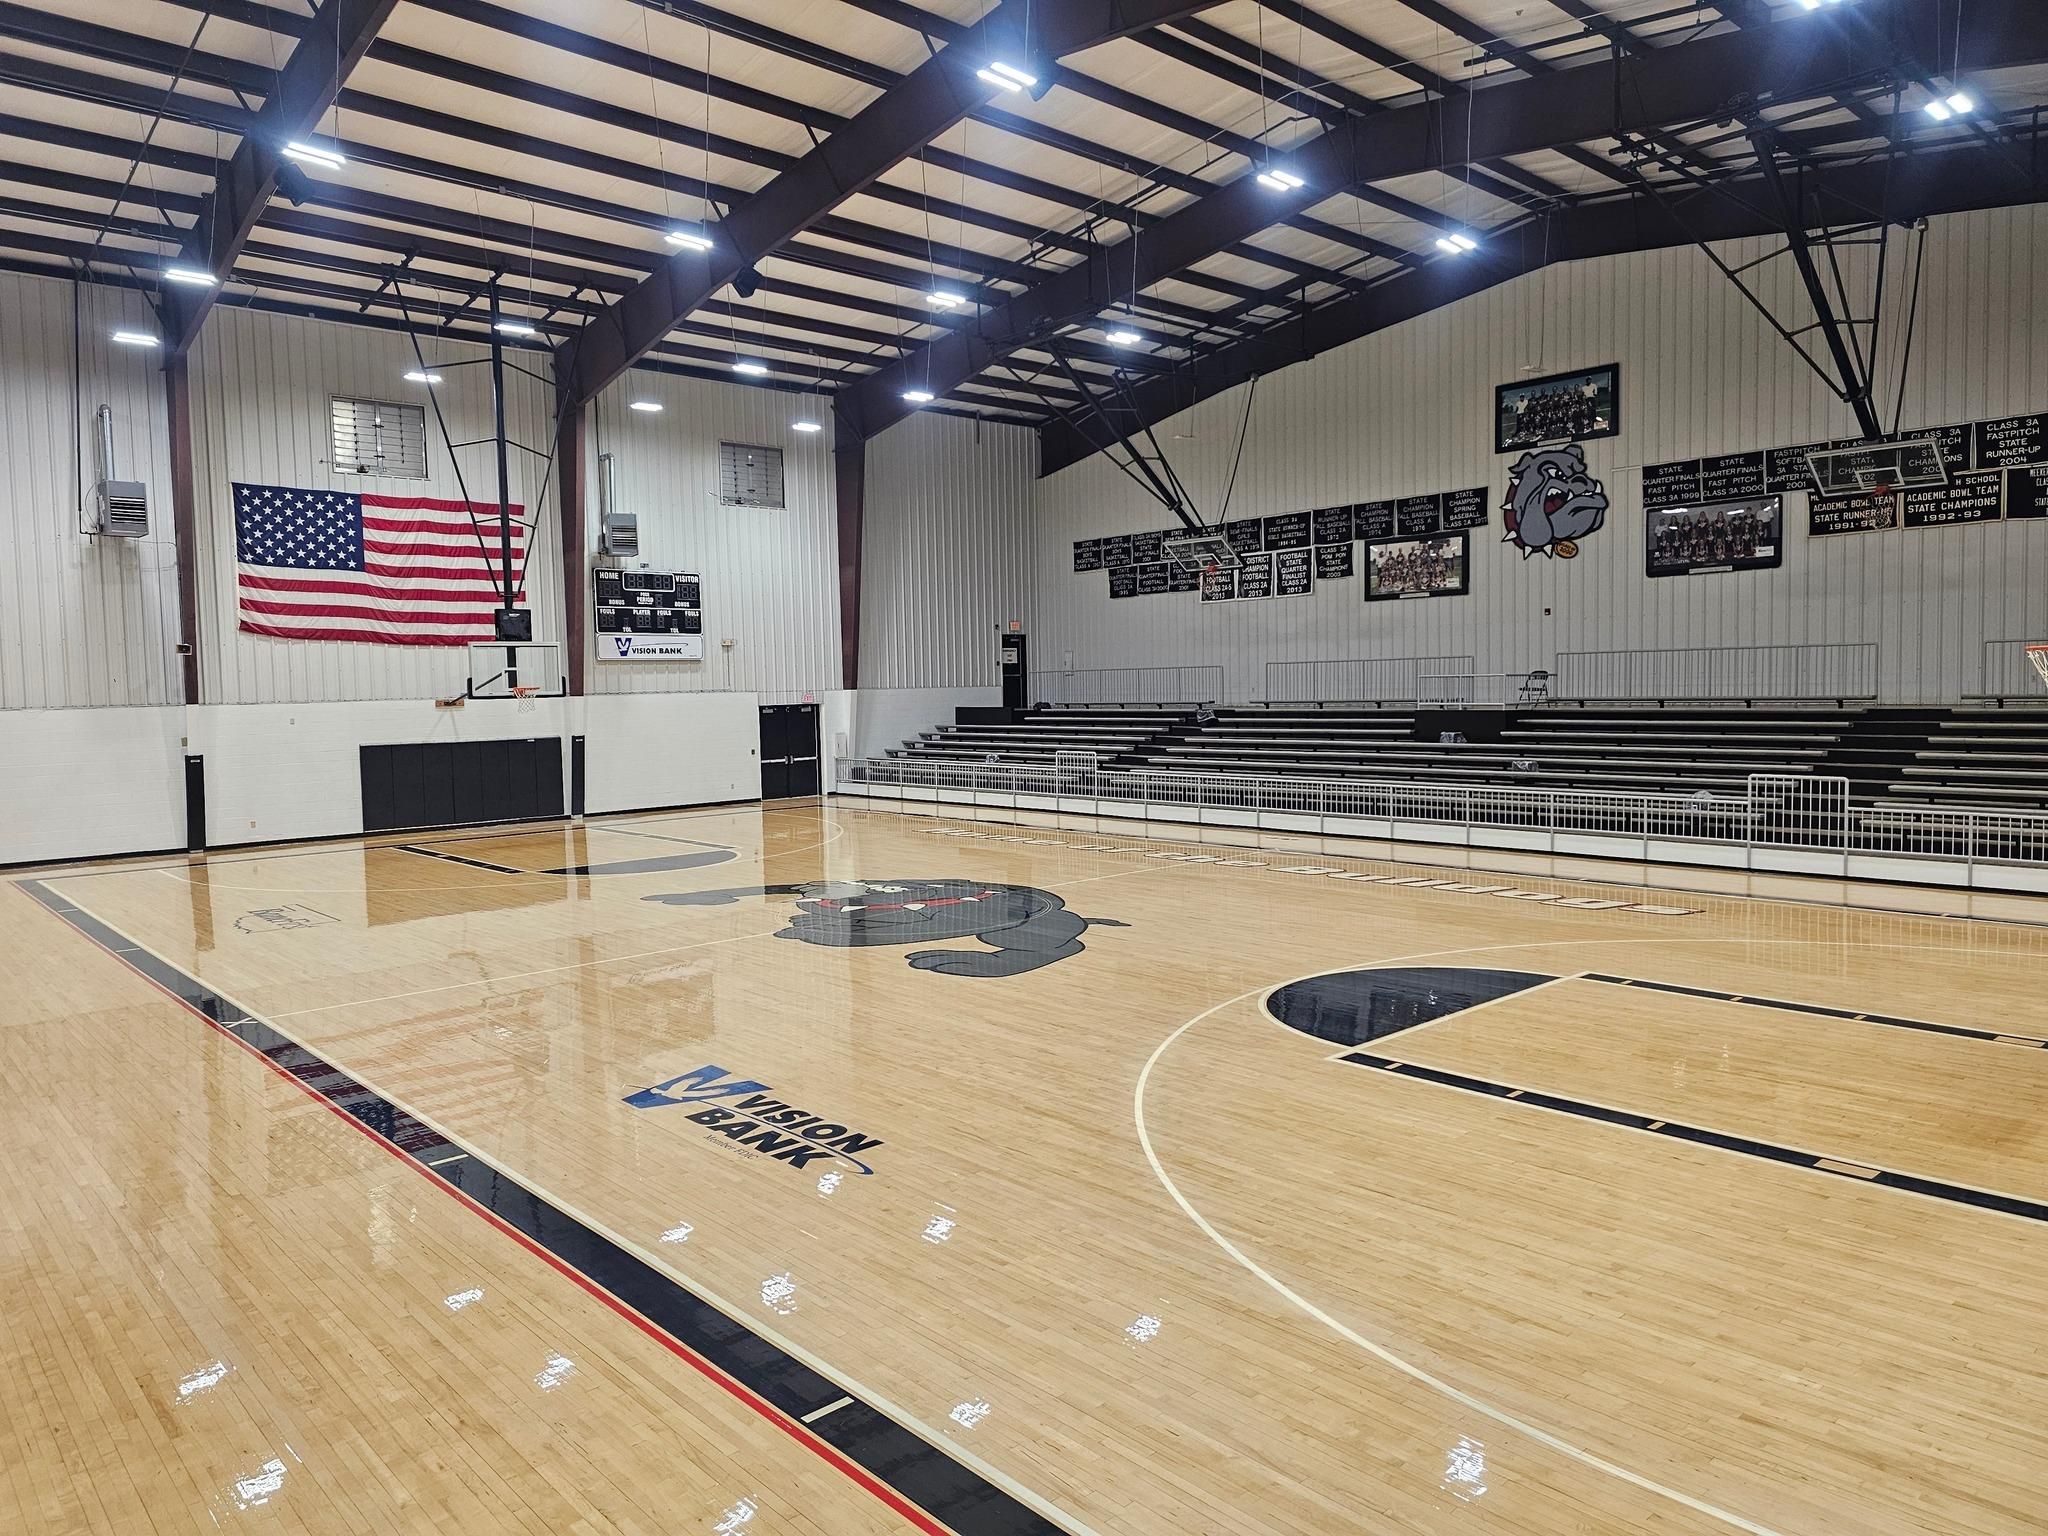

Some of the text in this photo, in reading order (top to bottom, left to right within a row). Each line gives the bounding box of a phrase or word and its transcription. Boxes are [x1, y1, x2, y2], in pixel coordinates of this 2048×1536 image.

[1987, 420, 2019, 431] CLASS
[1949, 428, 1961, 436] 3A
[1986, 427, 2040, 440] FASTPITCH
[1999, 438, 2028, 448] STATE
[1774, 445, 1820, 458] FASTPITCH
[1986, 446, 2041, 458] RUNNER-UP
[1720, 457, 1745, 467] STATE
[2000, 457, 2027, 466] 2004
[1658, 465, 1683, 475] STATE
[1922, 465, 1942, 474] 200
[1708, 475, 1757, 487] FAST PITCH
[1765, 473, 1800, 483] QUARTER
[1965, 475, 2000, 485] SCHOOL
[1648, 483, 1695, 494] FAST PITCH
[1703, 488, 1727, 497] CLASS
[1740, 483, 1764, 493] 2000
[1786, 481, 1807, 489] 2001
[1455, 491, 1474, 499] STATE
[1907, 485, 1999, 502] ACADEMIC BOWL TEAM
[1409, 497, 1428, 505] STATE
[1449, 497, 1481, 507] CHAMPION
[1644, 495, 1667, 504] CLASS
[1813, 495, 1894, 512] ACADEMIC BOWL TEAM
[1403, 504, 1434, 513] CHAMPION
[1453, 505, 1477, 513] SPRING
[1908, 497, 1997, 513] STATE CHAMPIONS
[1324, 508, 1341, 517] STATE
[1360, 508, 1389, 518] CHAMPION
[1411, 510, 1439, 518] BASEBALL
[1449, 512, 1481, 521] BASEBALL
[1814, 513, 1840, 523] STATE
[1362, 523, 1381, 531] CLASS
[1280, 552, 1308, 560] FOOTBALL
[1281, 565, 1307, 574] QUARTER
[599, 571, 619, 580] HOME
[674, 575, 699, 583] VISITOR
[1243, 573, 1269, 581] FOOTBALL
[1282, 572, 1306, 580] FINALIST
[1244, 582, 1260, 590] CLASS
[631, 647, 682, 655] VISION BANK
[1265, 865, 1707, 915] Bulldogs
[734, 1094, 885, 1154] VISION
[684, 1107, 837, 1169] BANK
[703, 1134, 737, 1151] Member
